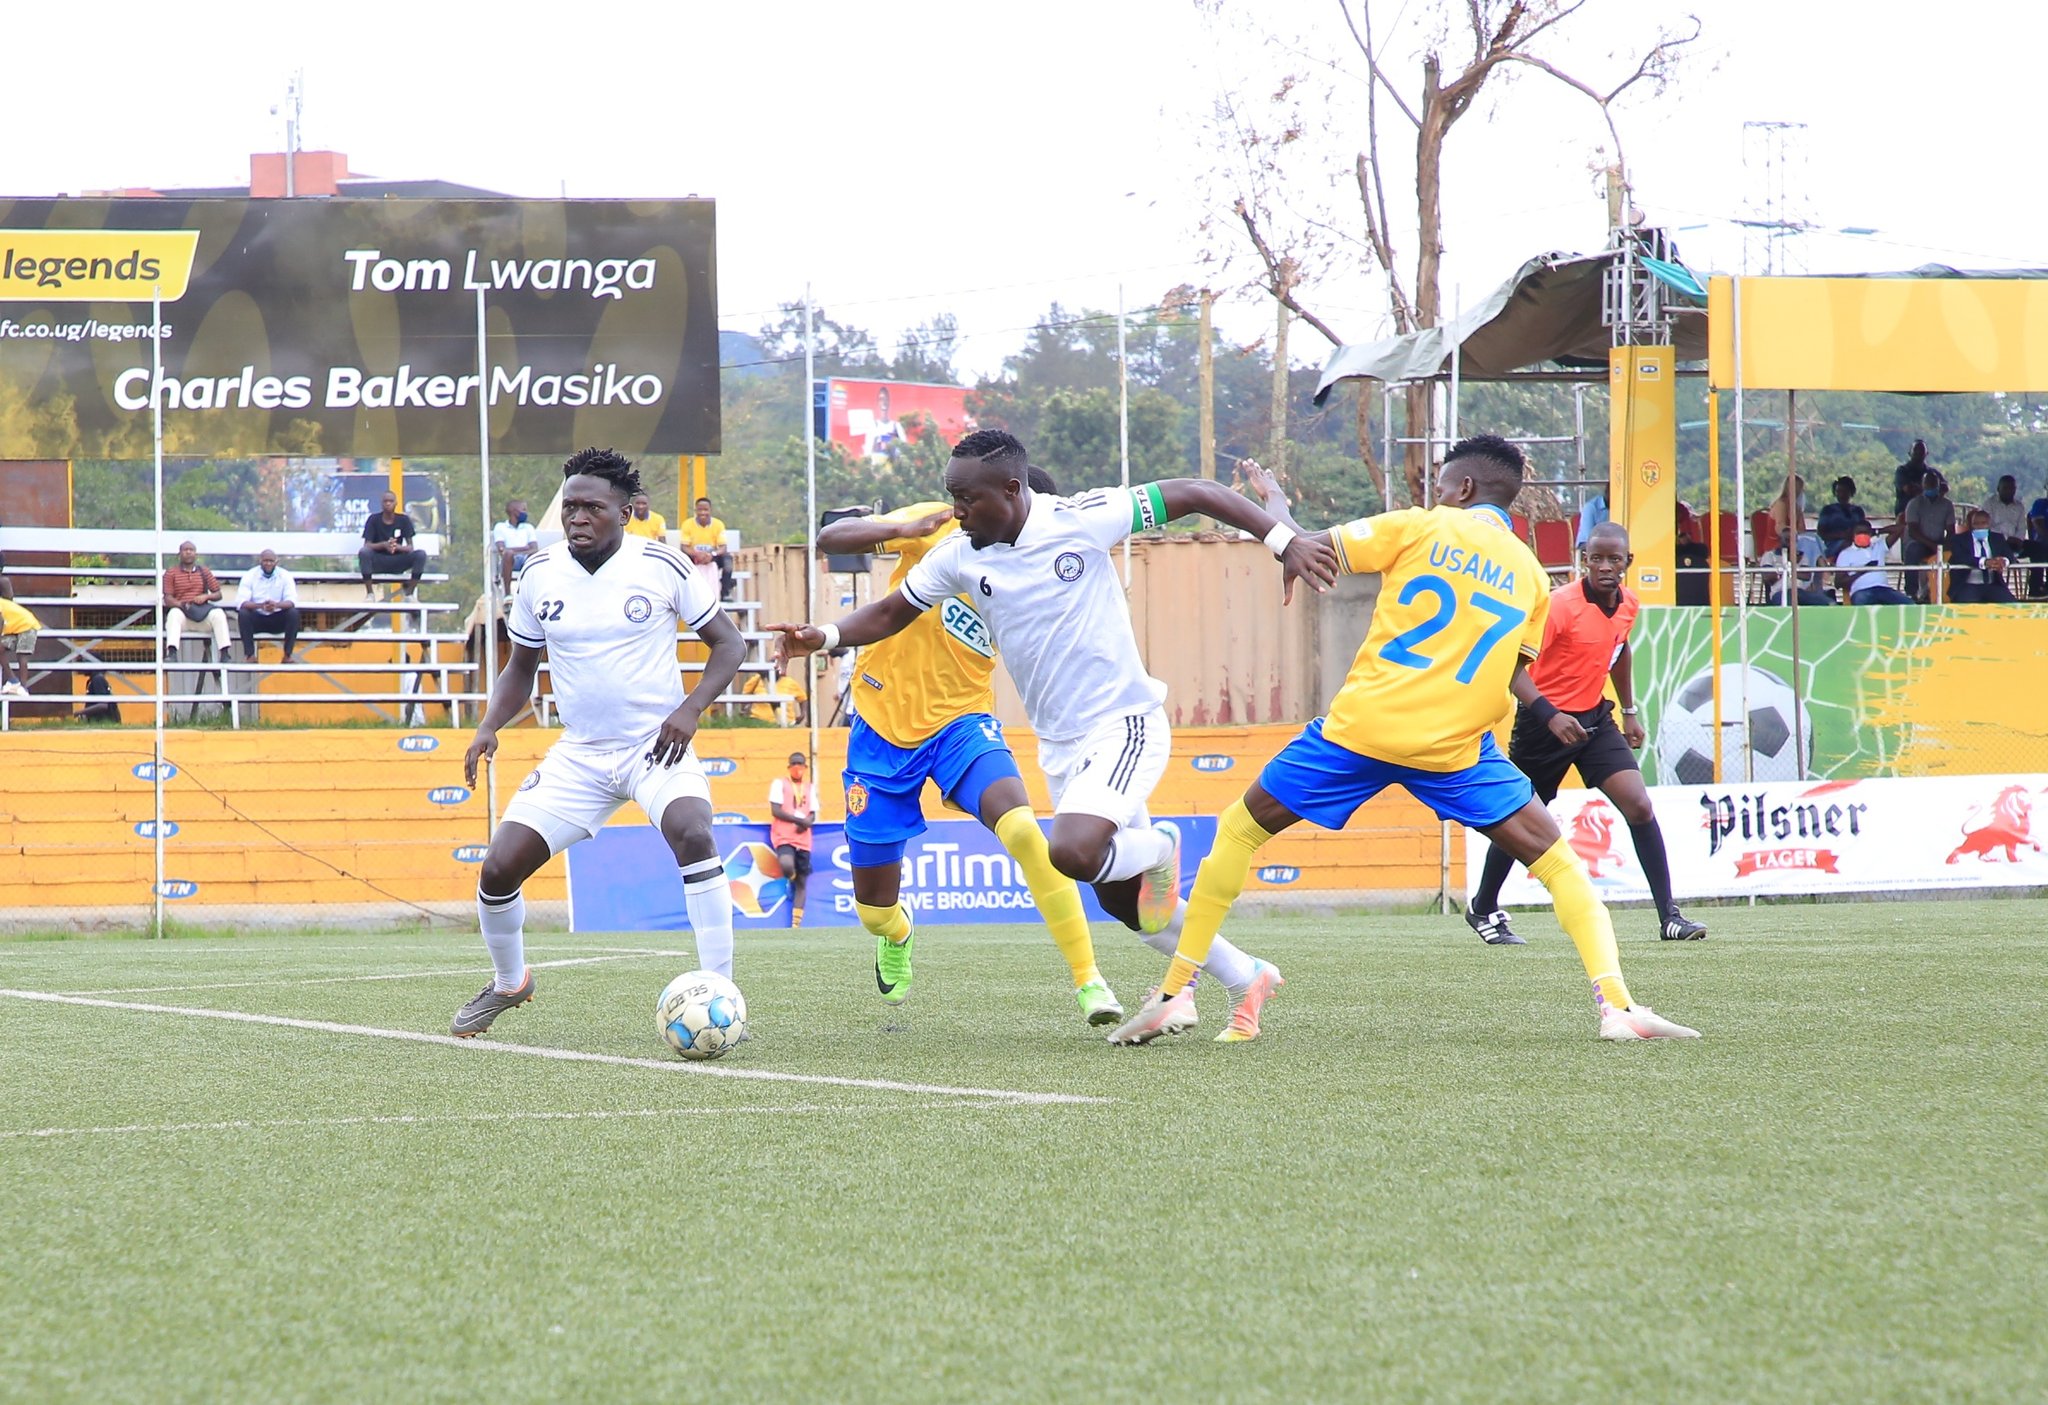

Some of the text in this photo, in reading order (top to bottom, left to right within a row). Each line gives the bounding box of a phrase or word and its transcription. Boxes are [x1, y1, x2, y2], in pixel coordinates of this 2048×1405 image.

[3, 248, 160, 288] legends
[344, 250, 656, 299] Tom Lwanga
[114, 363, 663, 411] Charles Baker Masiko
[1429, 541, 1516, 595] USAMA
[979, 576, 992, 597] 6
[535, 600, 565, 621] 32
[944, 604, 990, 648] SEE TV
[1378, 574, 1527, 685] 27
[402, 738, 434, 749] MTN
[1197, 757, 1228, 769] MTN
[432, 789, 463, 802] MTN
[139, 822, 172, 835] MN
[1700, 790, 1868, 858] Pilsner
[831, 843, 1028, 891] SarTim
[1754, 850, 1819, 870] LAGER
[1262, 868, 1295, 881] MTN
[937, 890, 1035, 910] BROADCAS
